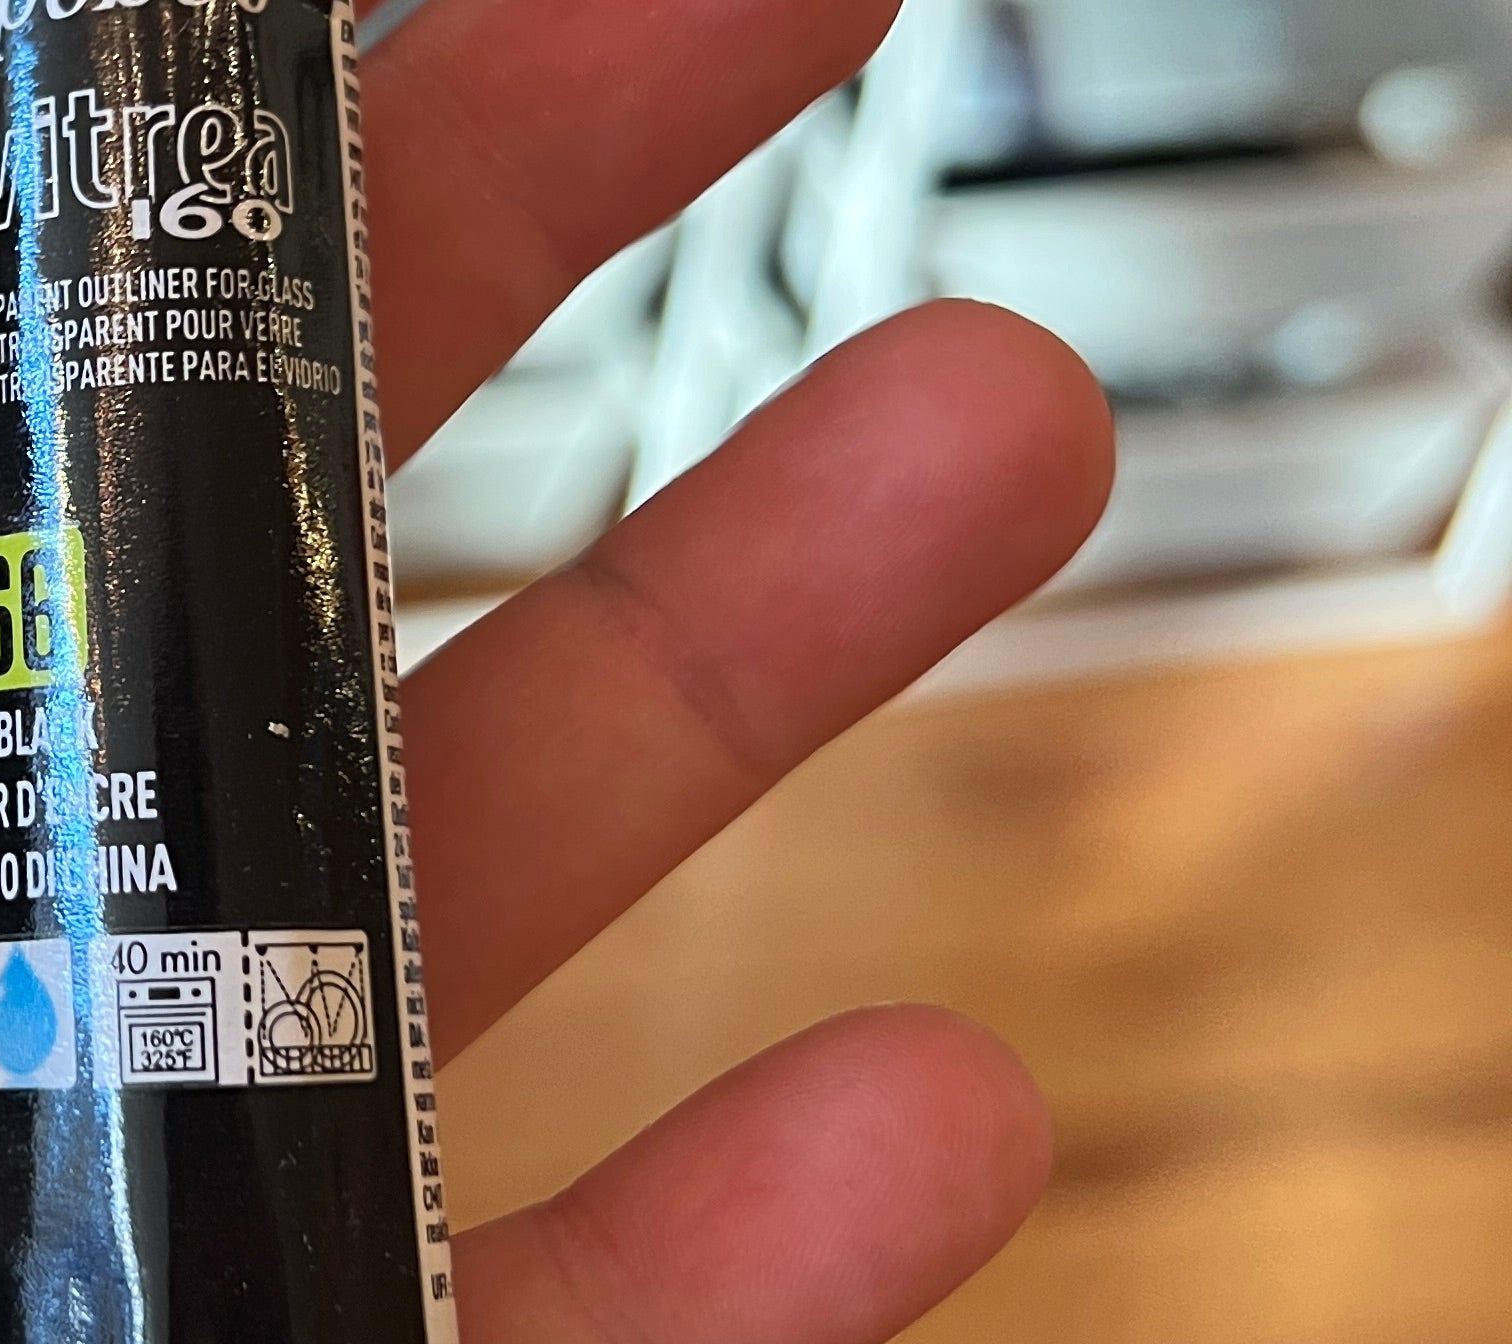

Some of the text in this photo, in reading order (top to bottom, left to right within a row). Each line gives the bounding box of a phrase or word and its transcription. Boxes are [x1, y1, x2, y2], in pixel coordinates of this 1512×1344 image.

[132, 183, 282, 241] 160
[78, 268, 198, 308] OUTLINER
[206, 268, 254, 299] FOR
[258, 271, 314, 310] GLASS
[166, 309, 233, 341] POUR
[240, 311, 303, 347] VERRE
[0, 351, 174, 404] TRSPARENTE
[182, 350, 250, 381] PARA
[256, 351, 280, 383] EL
[281, 355, 341, 395] VIDRIO
[26, 849, 56, 899] DI
[111, 940, 221, 974] 40 min
[141, 1028, 193, 1047] 160°C
